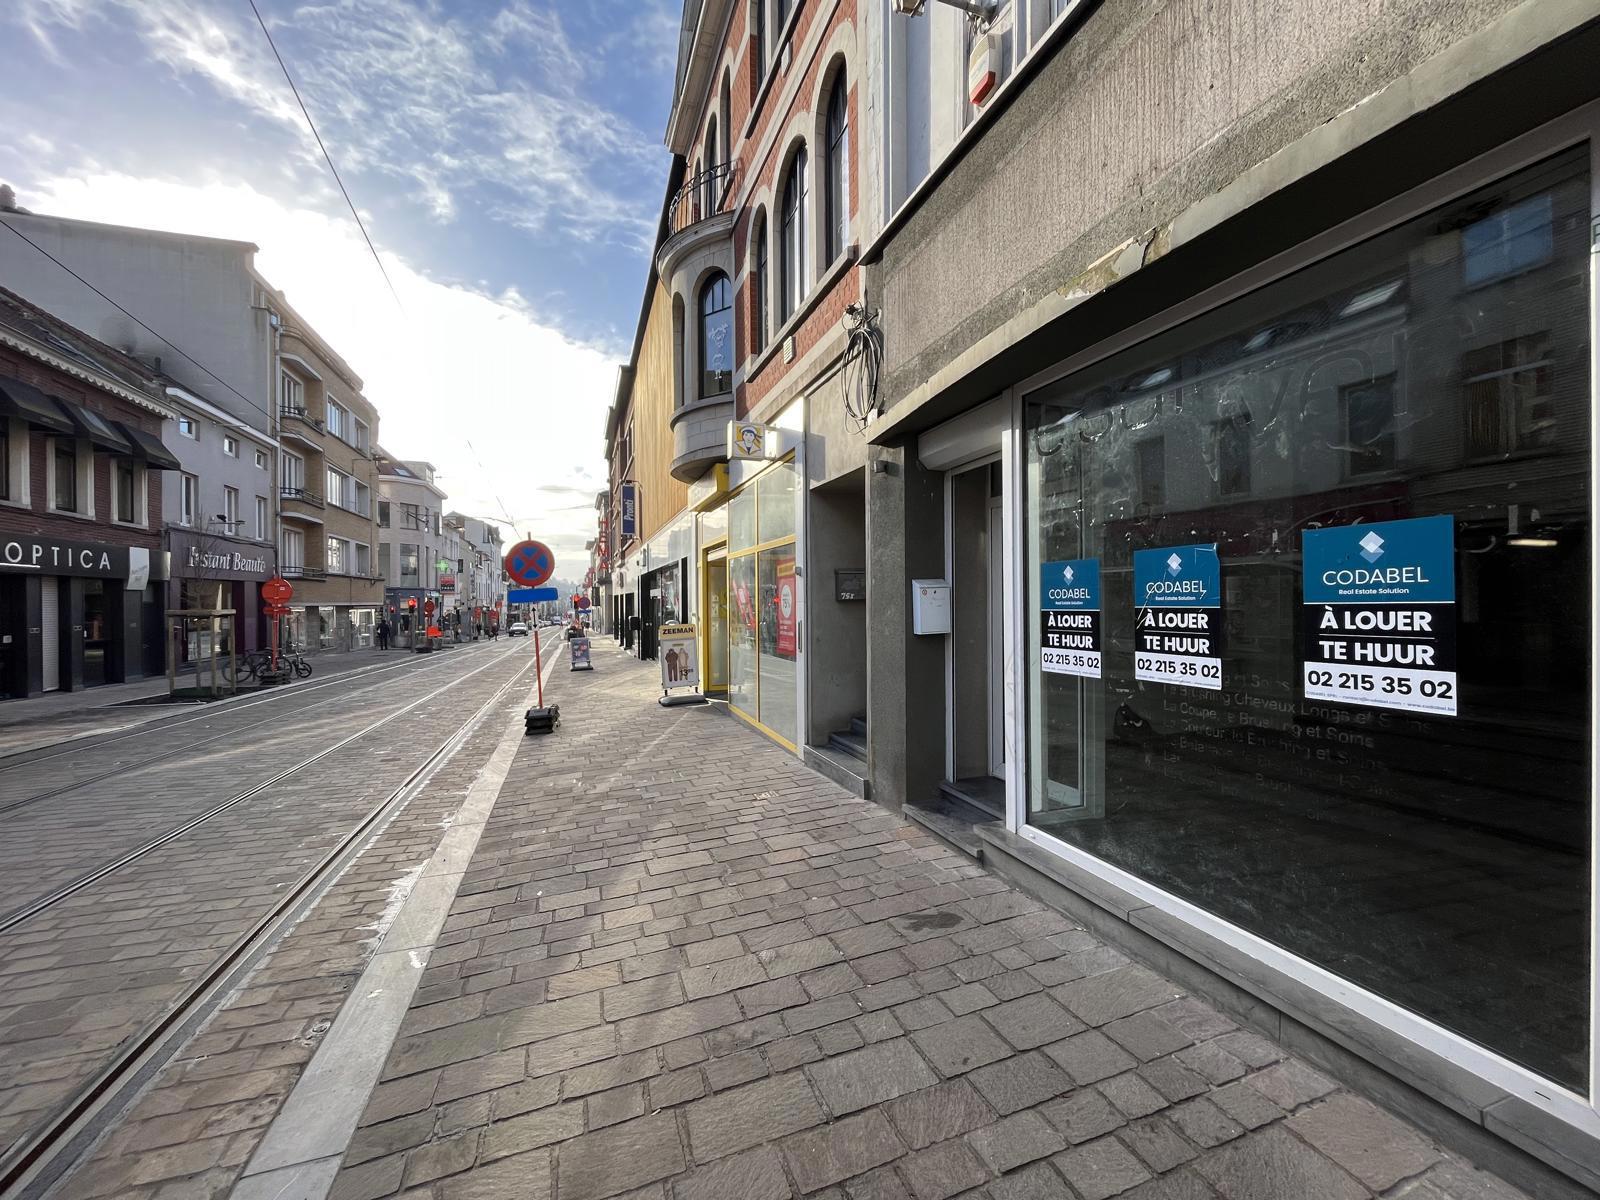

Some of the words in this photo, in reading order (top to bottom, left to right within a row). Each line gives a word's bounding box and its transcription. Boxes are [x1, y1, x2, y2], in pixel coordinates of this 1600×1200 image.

[623, 499, 634, 520] Pronti
[4, 542, 110, 570] OPTICA
[1322, 567, 1429, 585] CODABEL
[1048, 588, 1091, 599] CODABEL
[1146, 580, 1207, 593] CODABEL
[1048, 611, 1056, 627] À
[1058, 615, 1092, 628] LOUER
[1144, 609, 1155, 627] À
[1159, 613, 1208, 629] LOUER
[1320, 605, 1338, 629] À
[1344, 611, 1432, 631] LOUER
[662, 627, 693, 635] ZEEMAN
[1047, 634, 1059, 646] TE
[1062, 634, 1093, 649] HUUR
[1143, 635, 1160, 650] TE
[1164, 637, 1210, 654] HUUR
[1043, 653, 1054, 663] 02
[1055, 654, 1070, 665] 215
[1073, 656, 1084, 667] 35
[1087, 657, 1099, 668] 02
[1319, 641, 1347, 660] TE
[1354, 642, 1435, 666] HUUR
[1137, 658, 1152, 671] 02
[1155, 660, 1176, 673] 215
[1180, 662, 1197, 676] 35
[1201, 664, 1219, 679] 02
[1307, 670, 1333, 687] 02
[1338, 672, 1375, 691] 215
[1381, 676, 1412, 695] 35
[1420, 680, 1453, 700] 02
